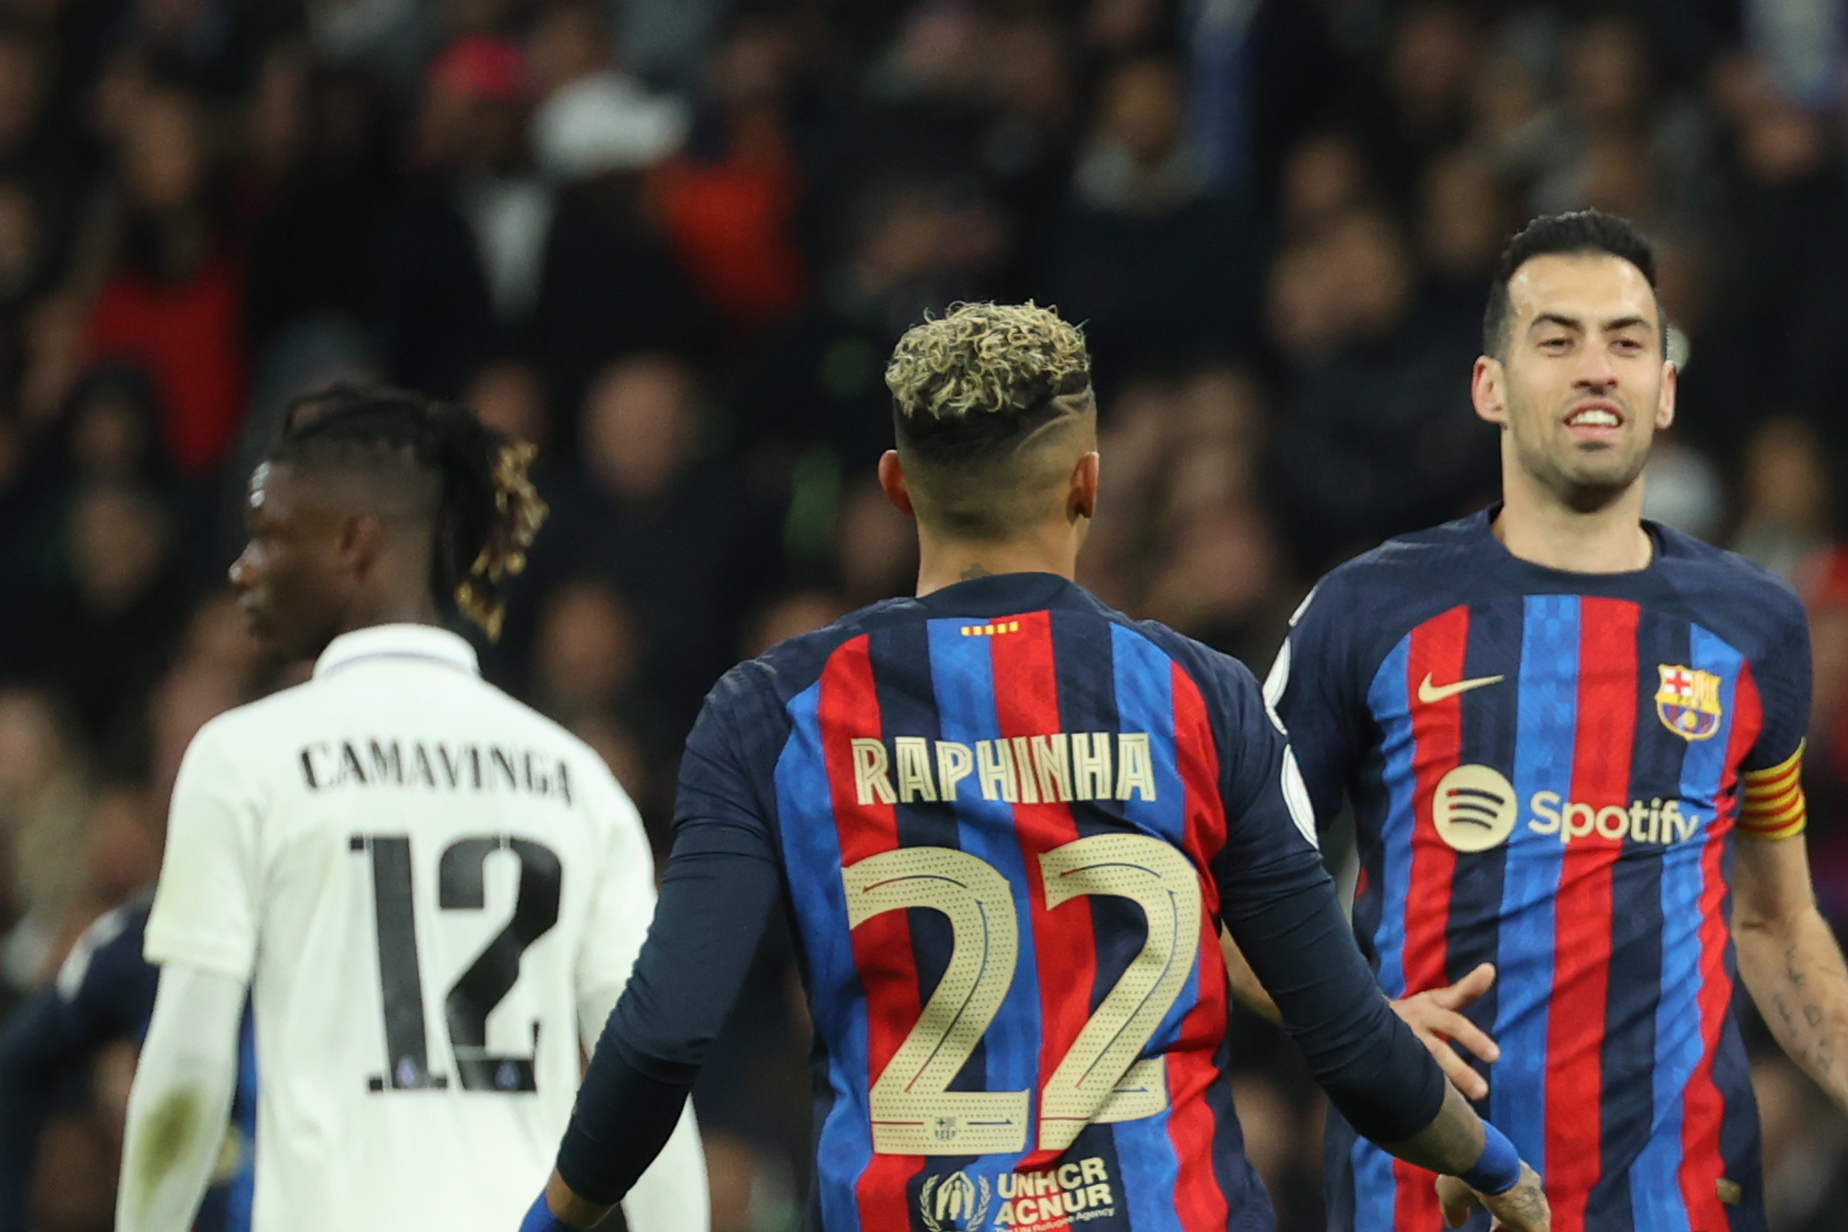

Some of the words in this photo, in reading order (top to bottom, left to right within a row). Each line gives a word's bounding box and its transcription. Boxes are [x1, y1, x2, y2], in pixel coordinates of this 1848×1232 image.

[298, 736, 573, 808] CAMAVINGA
[850, 732, 1157, 806] RAPHINHA
[1528, 790, 1699, 845] Spotify
[348, 832, 562, 1095] 12
[840, 832, 1202, 1155] 22
[994, 1183, 1114, 1225] ACNUR
[997, 1156, 1109, 1199] UNHCR
[1032, 1217, 1074, 1232] Refugee
[1076, 1207, 1115, 1221] Agency
